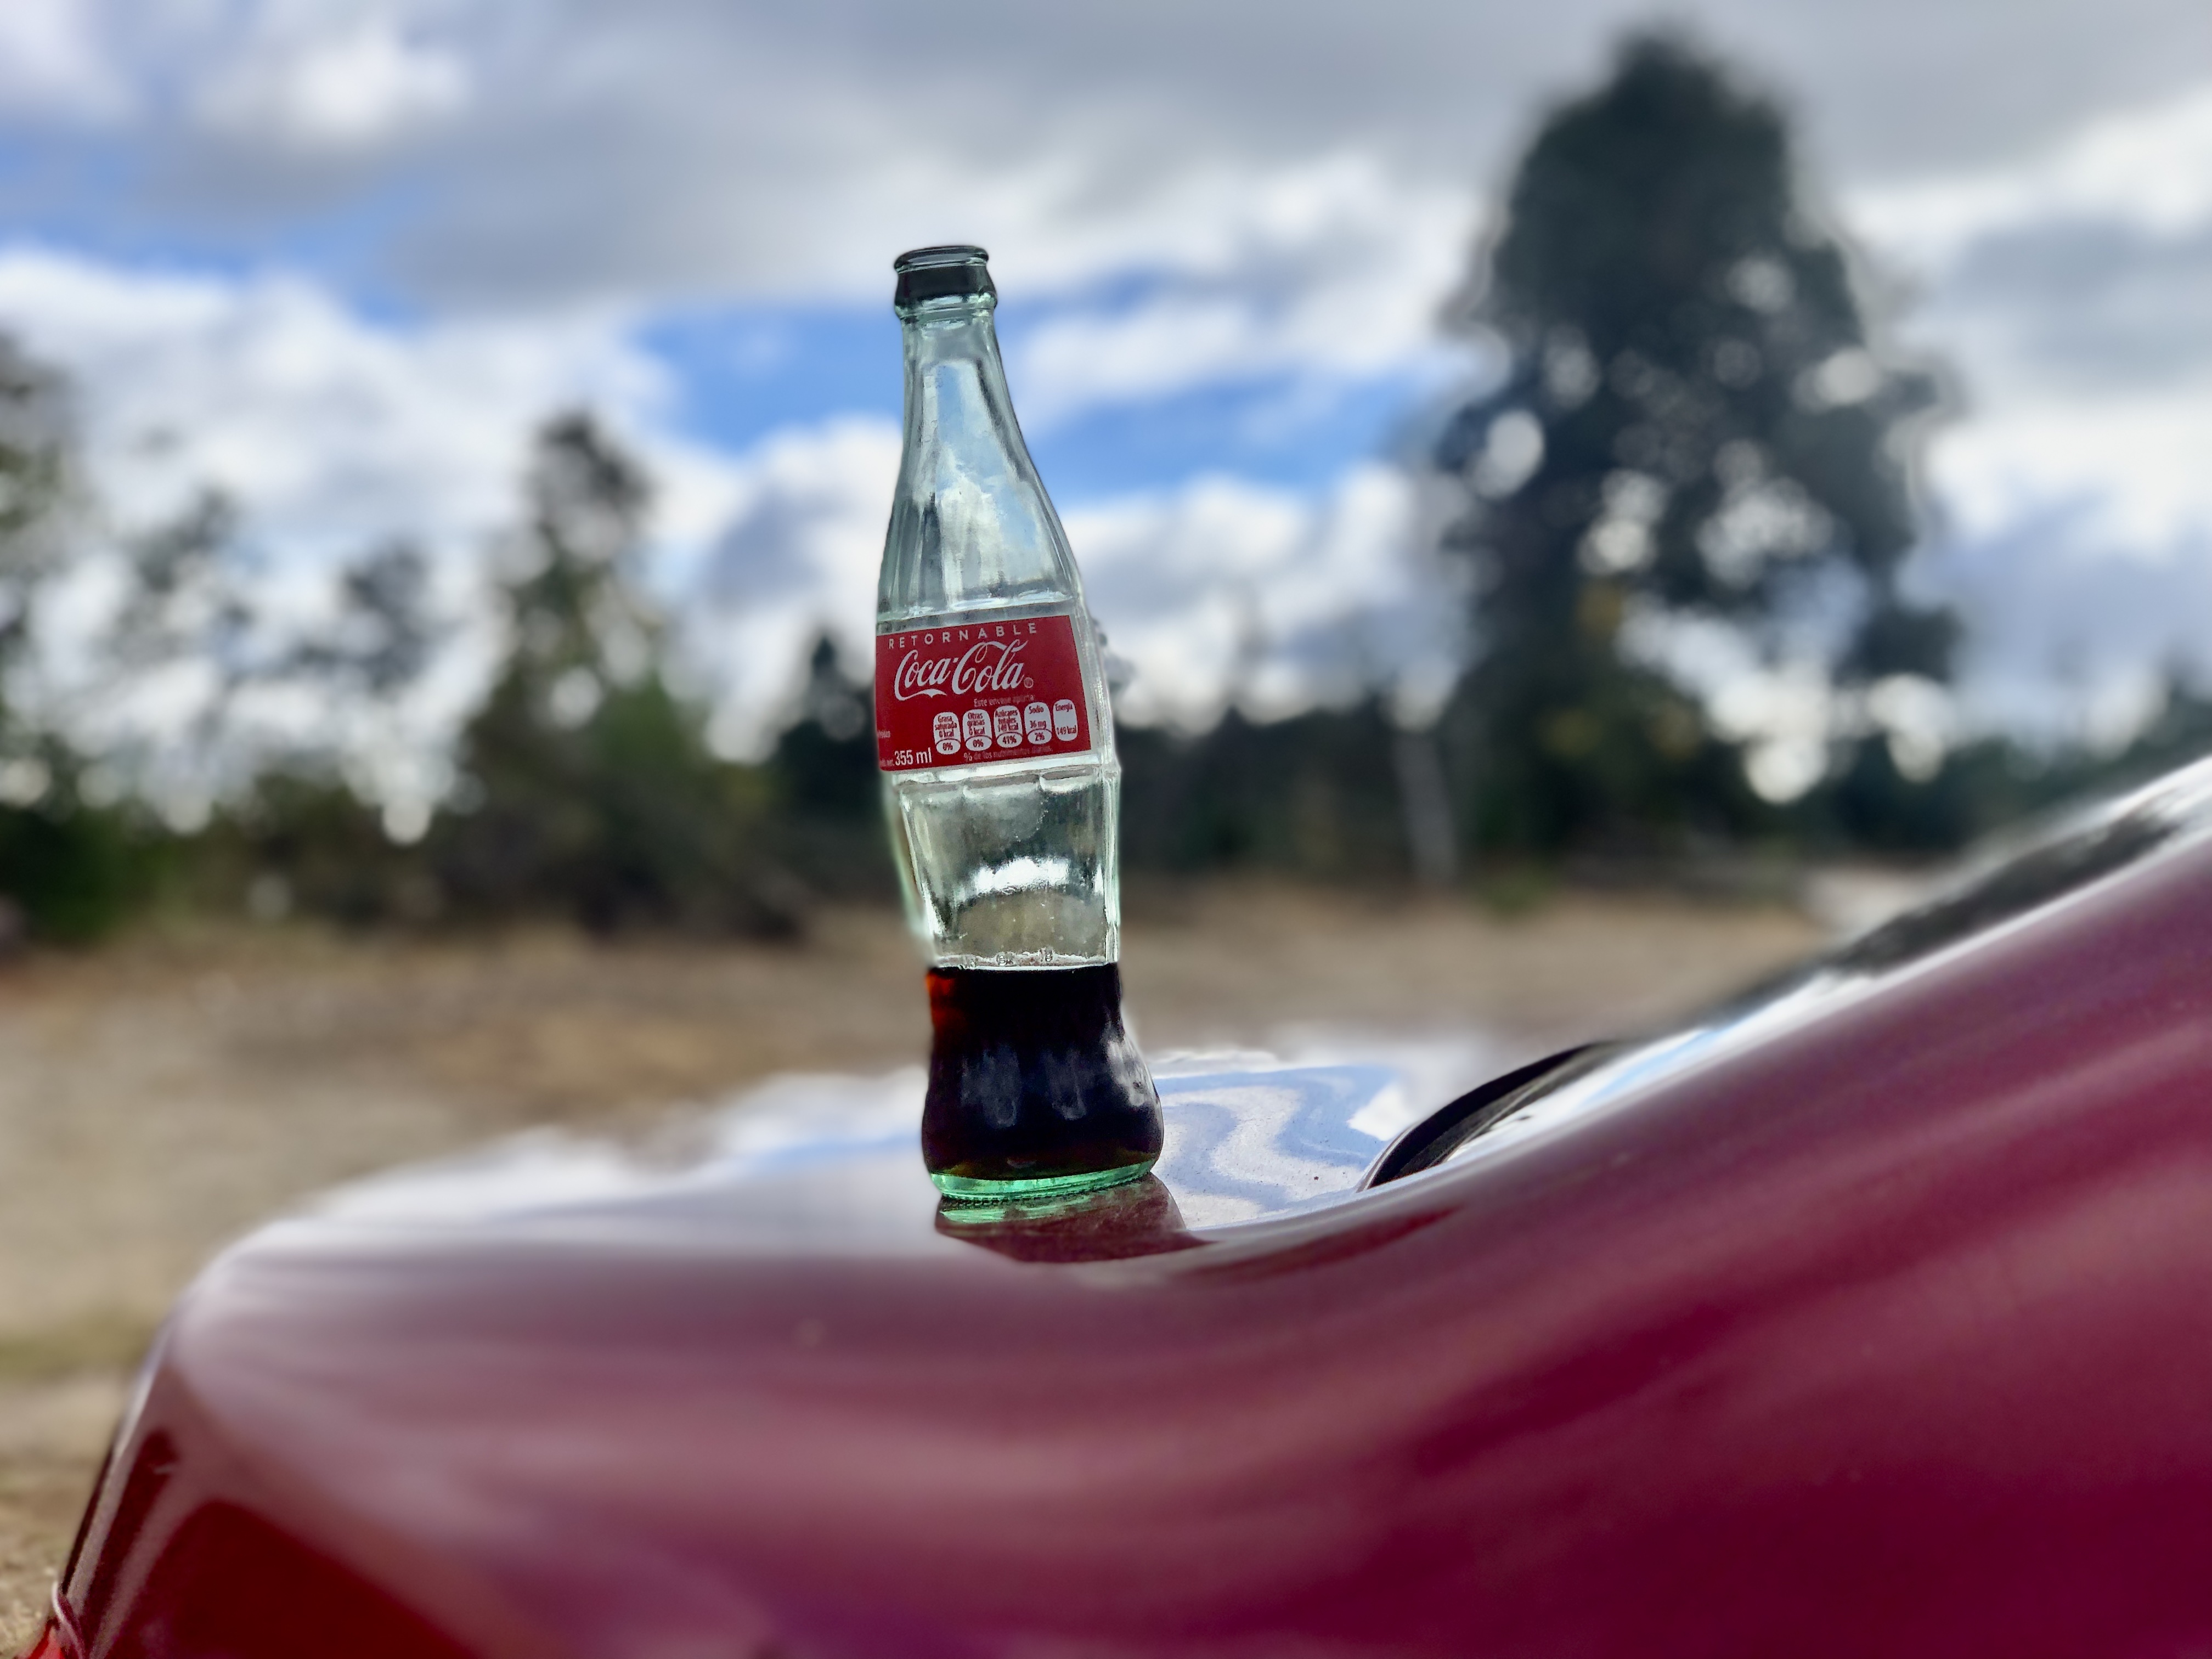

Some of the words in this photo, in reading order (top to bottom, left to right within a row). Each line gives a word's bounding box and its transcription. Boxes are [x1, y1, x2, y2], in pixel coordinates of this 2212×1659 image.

[889, 623, 1037, 649] RETORNABLE
[894, 639, 1028, 701] Coca-Cola
[1029, 705, 1044, 714] Sodio
[1002, 735, 1017, 744] 41%
[1035, 732, 1045, 741] 2%
[943, 742, 953, 751] 0%
[973, 740, 984, 748] 0%
[895, 750, 913, 766] 355
[917, 747, 933, 764] ml
